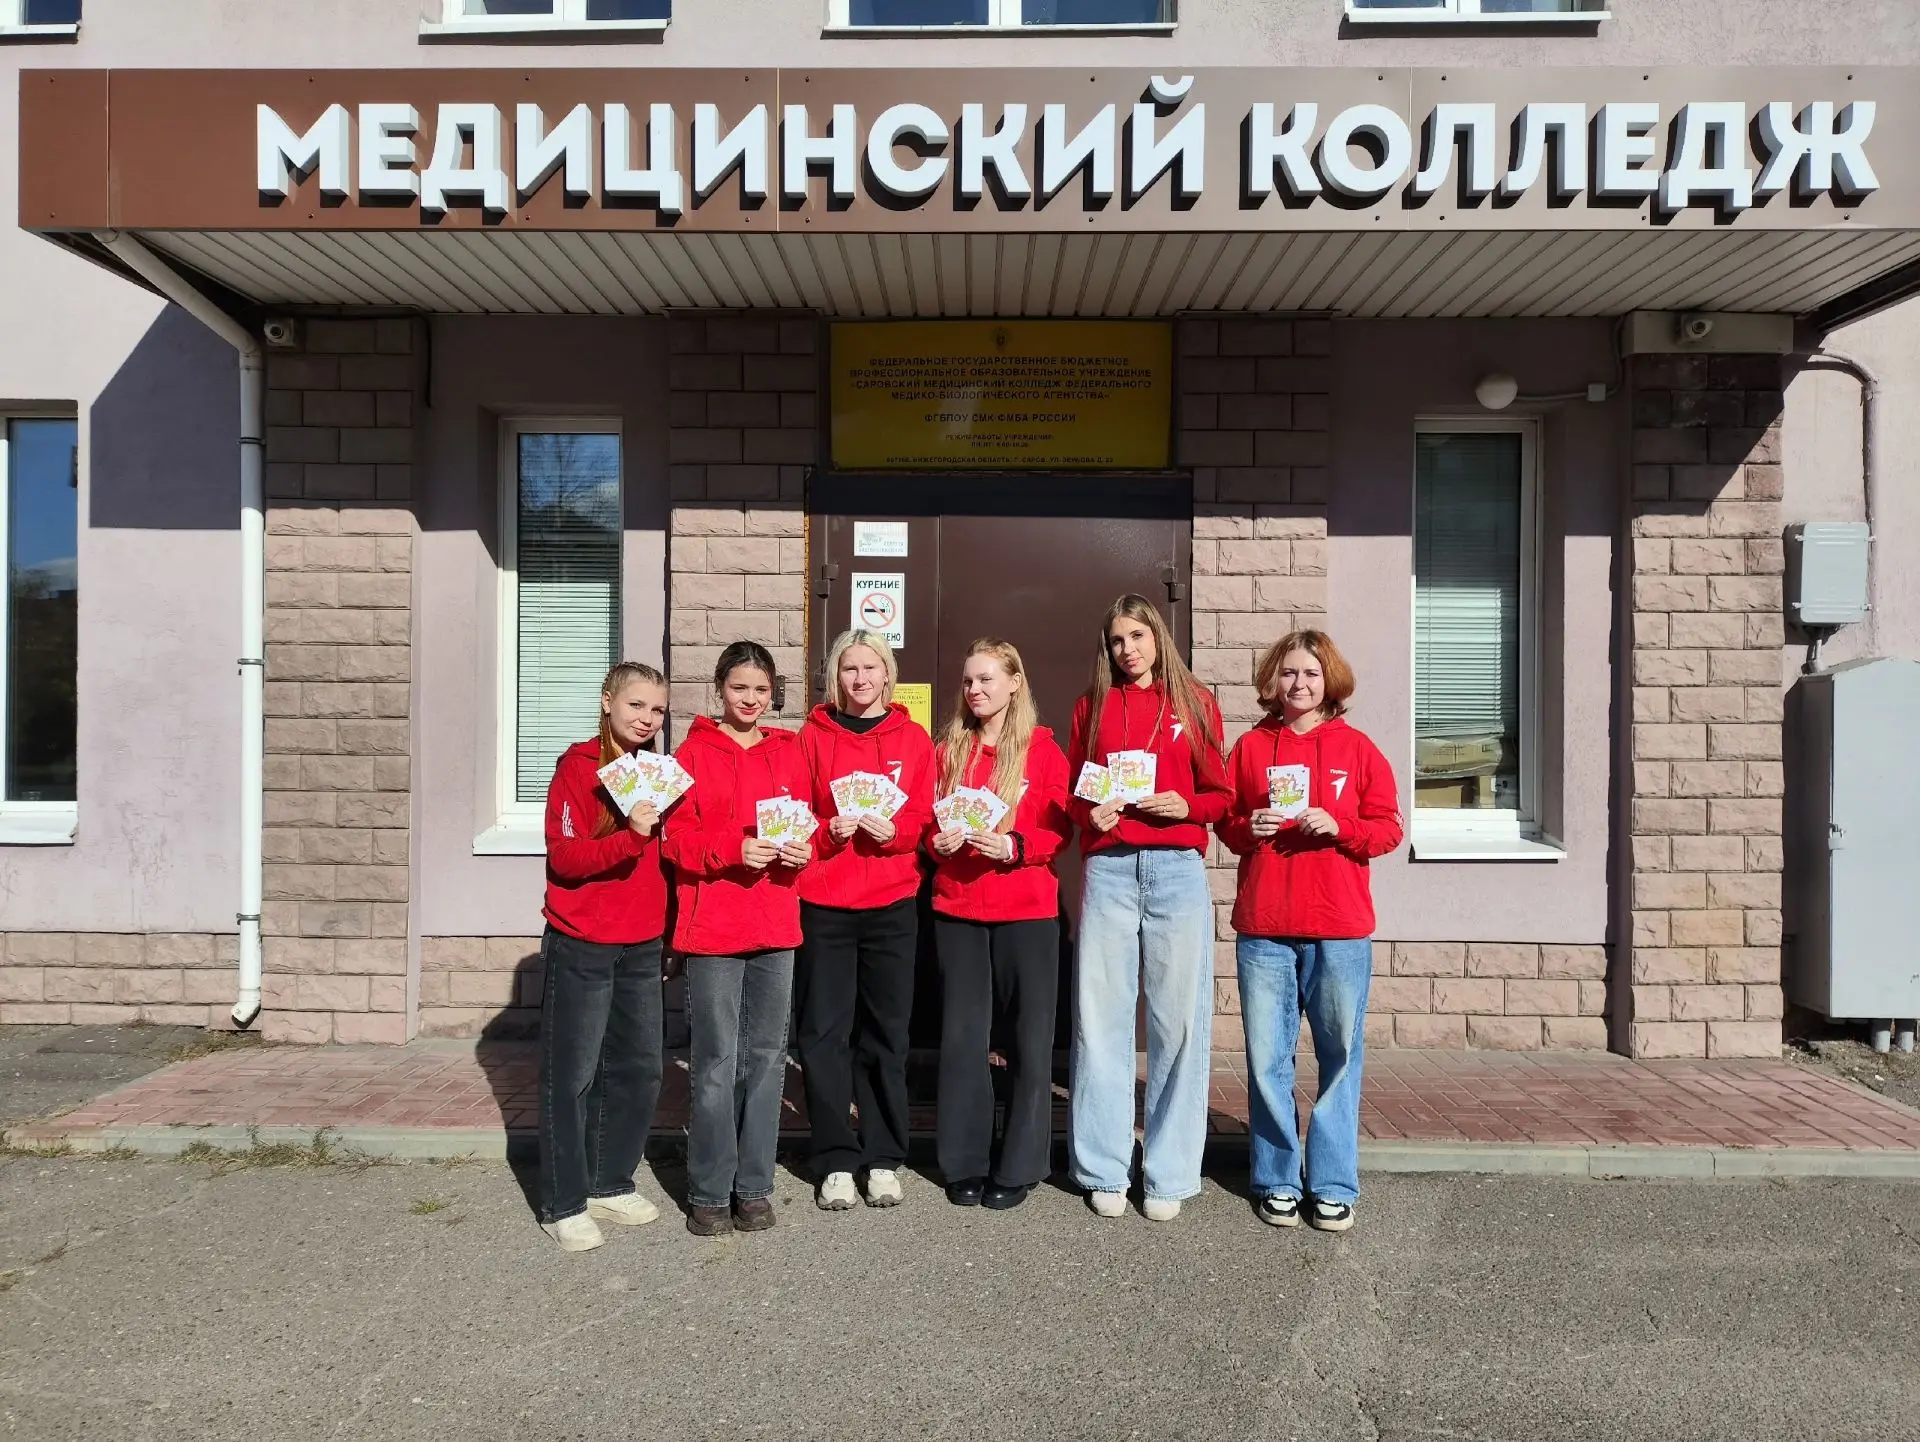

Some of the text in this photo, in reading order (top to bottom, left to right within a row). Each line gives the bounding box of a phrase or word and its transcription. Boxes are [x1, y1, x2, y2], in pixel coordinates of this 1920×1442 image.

[256, 75, 1880, 216] МЕДИЦИНСКИЙ КОЛЛЕДЖ
[869, 356, 1129, 367] ФЕДЕРАЛЬНОЕ ГОСУДАРСТВЕННОЕ БЮДЖЕТНОЕ
[849, 368, 1153, 378] ПРОФЕССИОНАЛЬНОЕ ОБРАЗОВАТЕЛЬНОЕ УЧРЕЖДЕНИЕ
[923, 379, 1005, 389] МЕДИЦИНСКИЙ
[1008, 380, 1062, 388] КОЛЛЕДЖ
[1065, 380, 1152, 389] ФЕДЕРАЛЬНОГО
[891, 391, 1040, 401] МЕДИКО-БИОЛОГИЧЕСКОГО
[924, 413, 1077, 422] ФГБПОУ СМК ФМБА РОССИИ
[856, 580, 901, 589] КУРЕНИЕ
